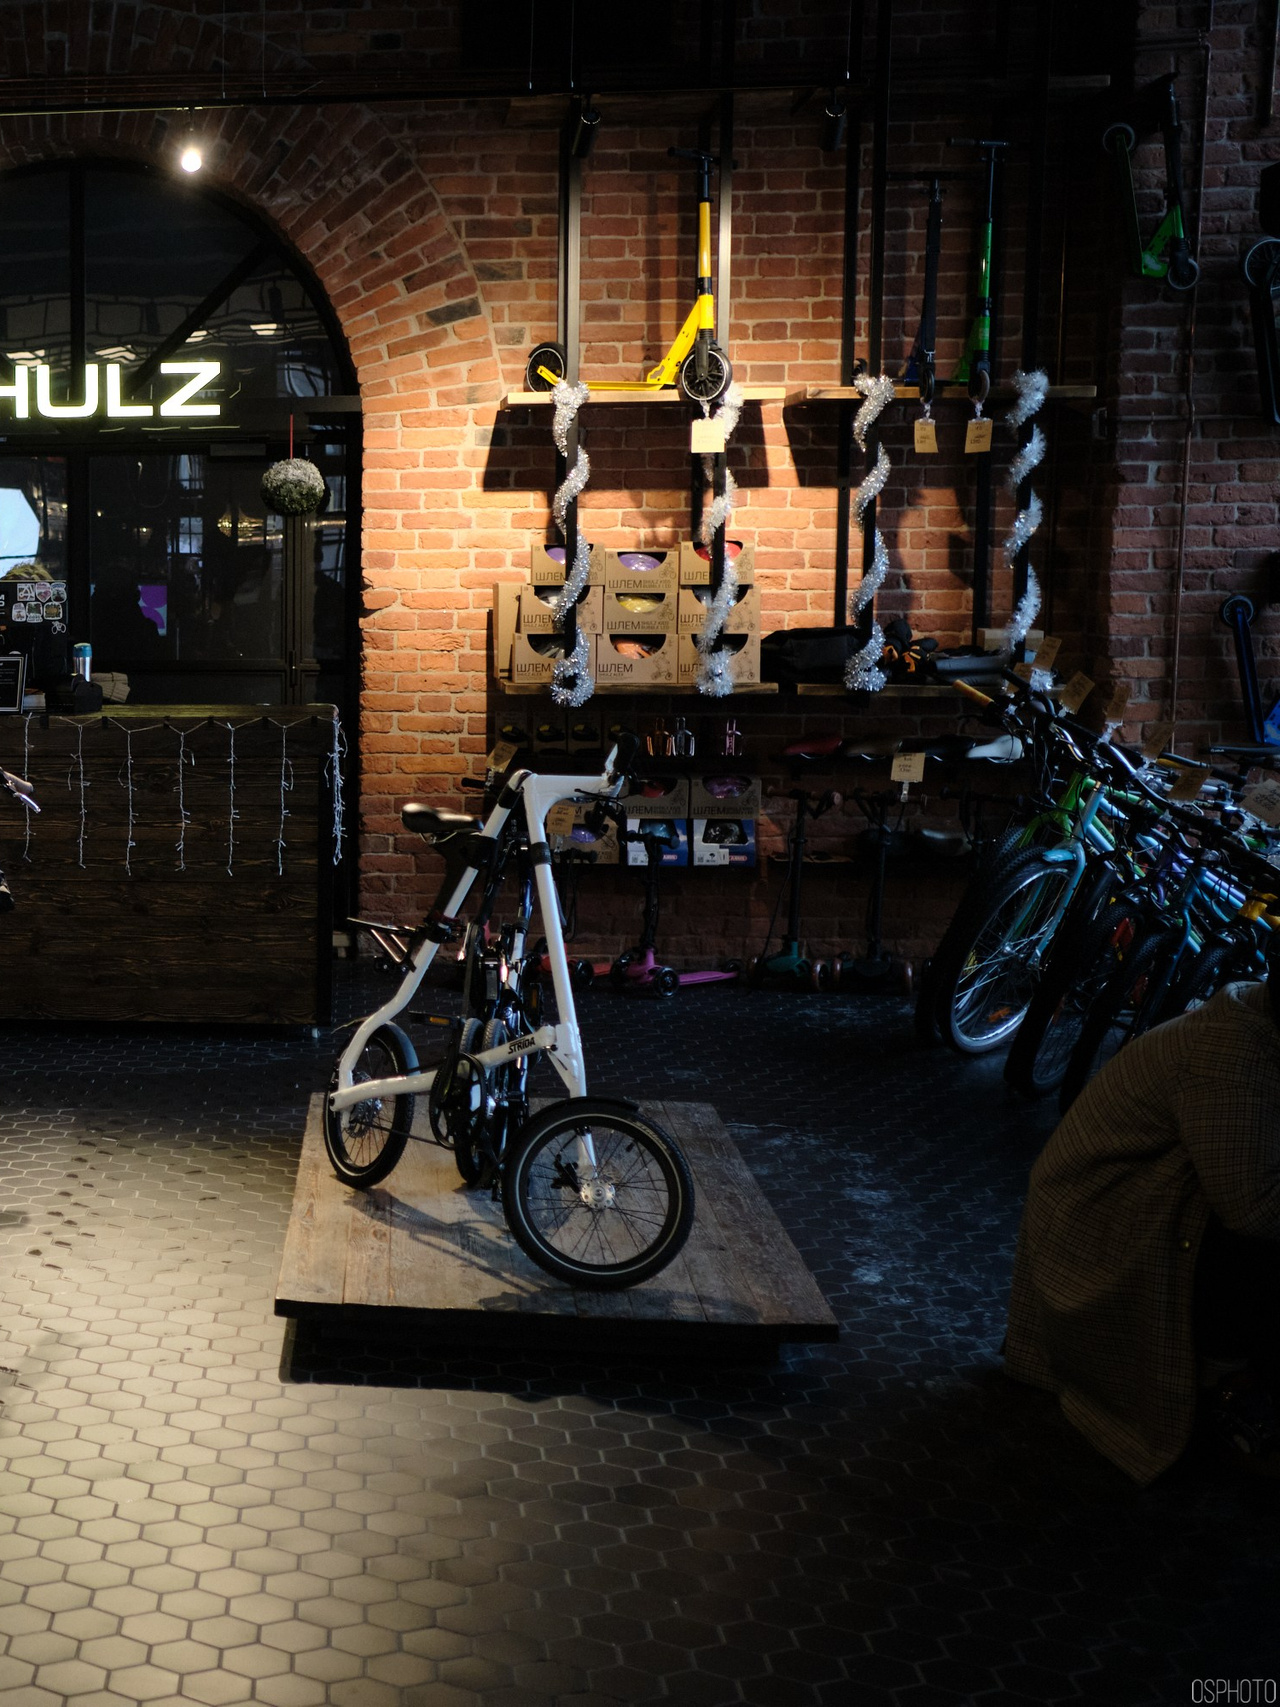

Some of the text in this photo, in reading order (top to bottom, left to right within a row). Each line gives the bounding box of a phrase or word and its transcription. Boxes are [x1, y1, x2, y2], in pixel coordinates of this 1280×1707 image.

[684, 571, 709, 580] ШЛЕ
[609, 580, 642, 588] ШЛЕМ
[680, 614, 705, 623] ШЛЕ
[607, 621, 640, 629] ШЛЕМ
[517, 663, 550, 672] ШЛЕМ
[599, 663, 632, 672] ШЛЕМ
[694, 805, 726, 814] ШЛЕМ
[508, 1037, 536, 1054] STRIDA
